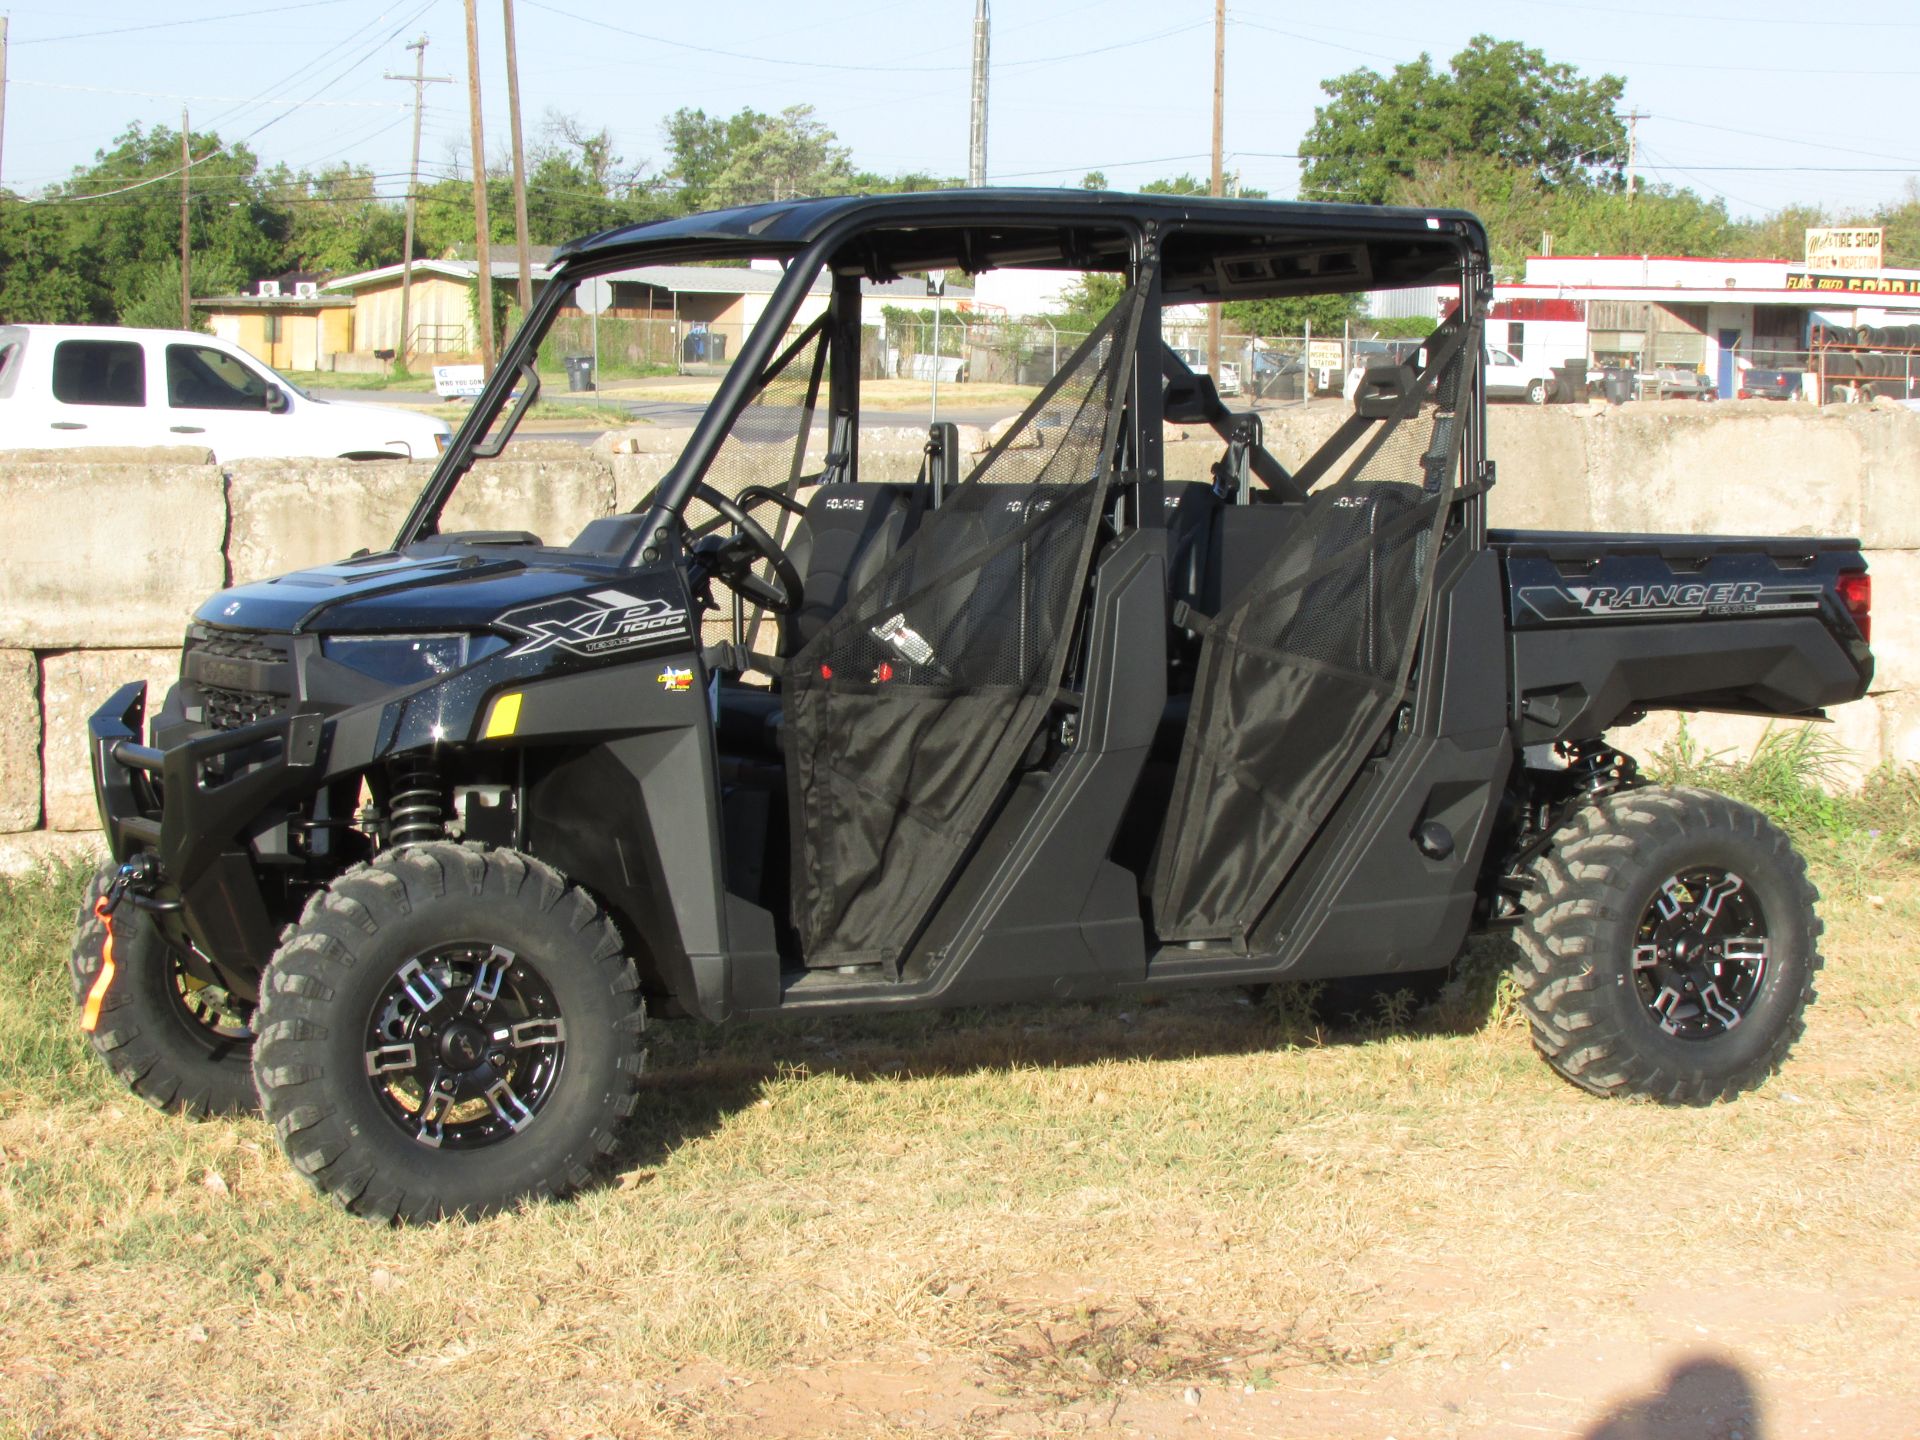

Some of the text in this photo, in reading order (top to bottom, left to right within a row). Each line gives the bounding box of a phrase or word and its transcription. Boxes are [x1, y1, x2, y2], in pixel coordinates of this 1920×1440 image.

[1833, 233, 1852, 248] TIRE
[1855, 232, 1879, 248] SHOP
[1808, 256, 1878, 270] STATE INSPECTION
[1817, 278, 1844, 289] FIXED
[1313, 359, 1337, 367] STATION
[825, 498, 865, 511] POLARIS
[1582, 582, 1763, 609] RANGER
[1708, 604, 1758, 615] TEXAS
[495, 599, 687, 658] XP
[623, 616, 686, 634] 1000
